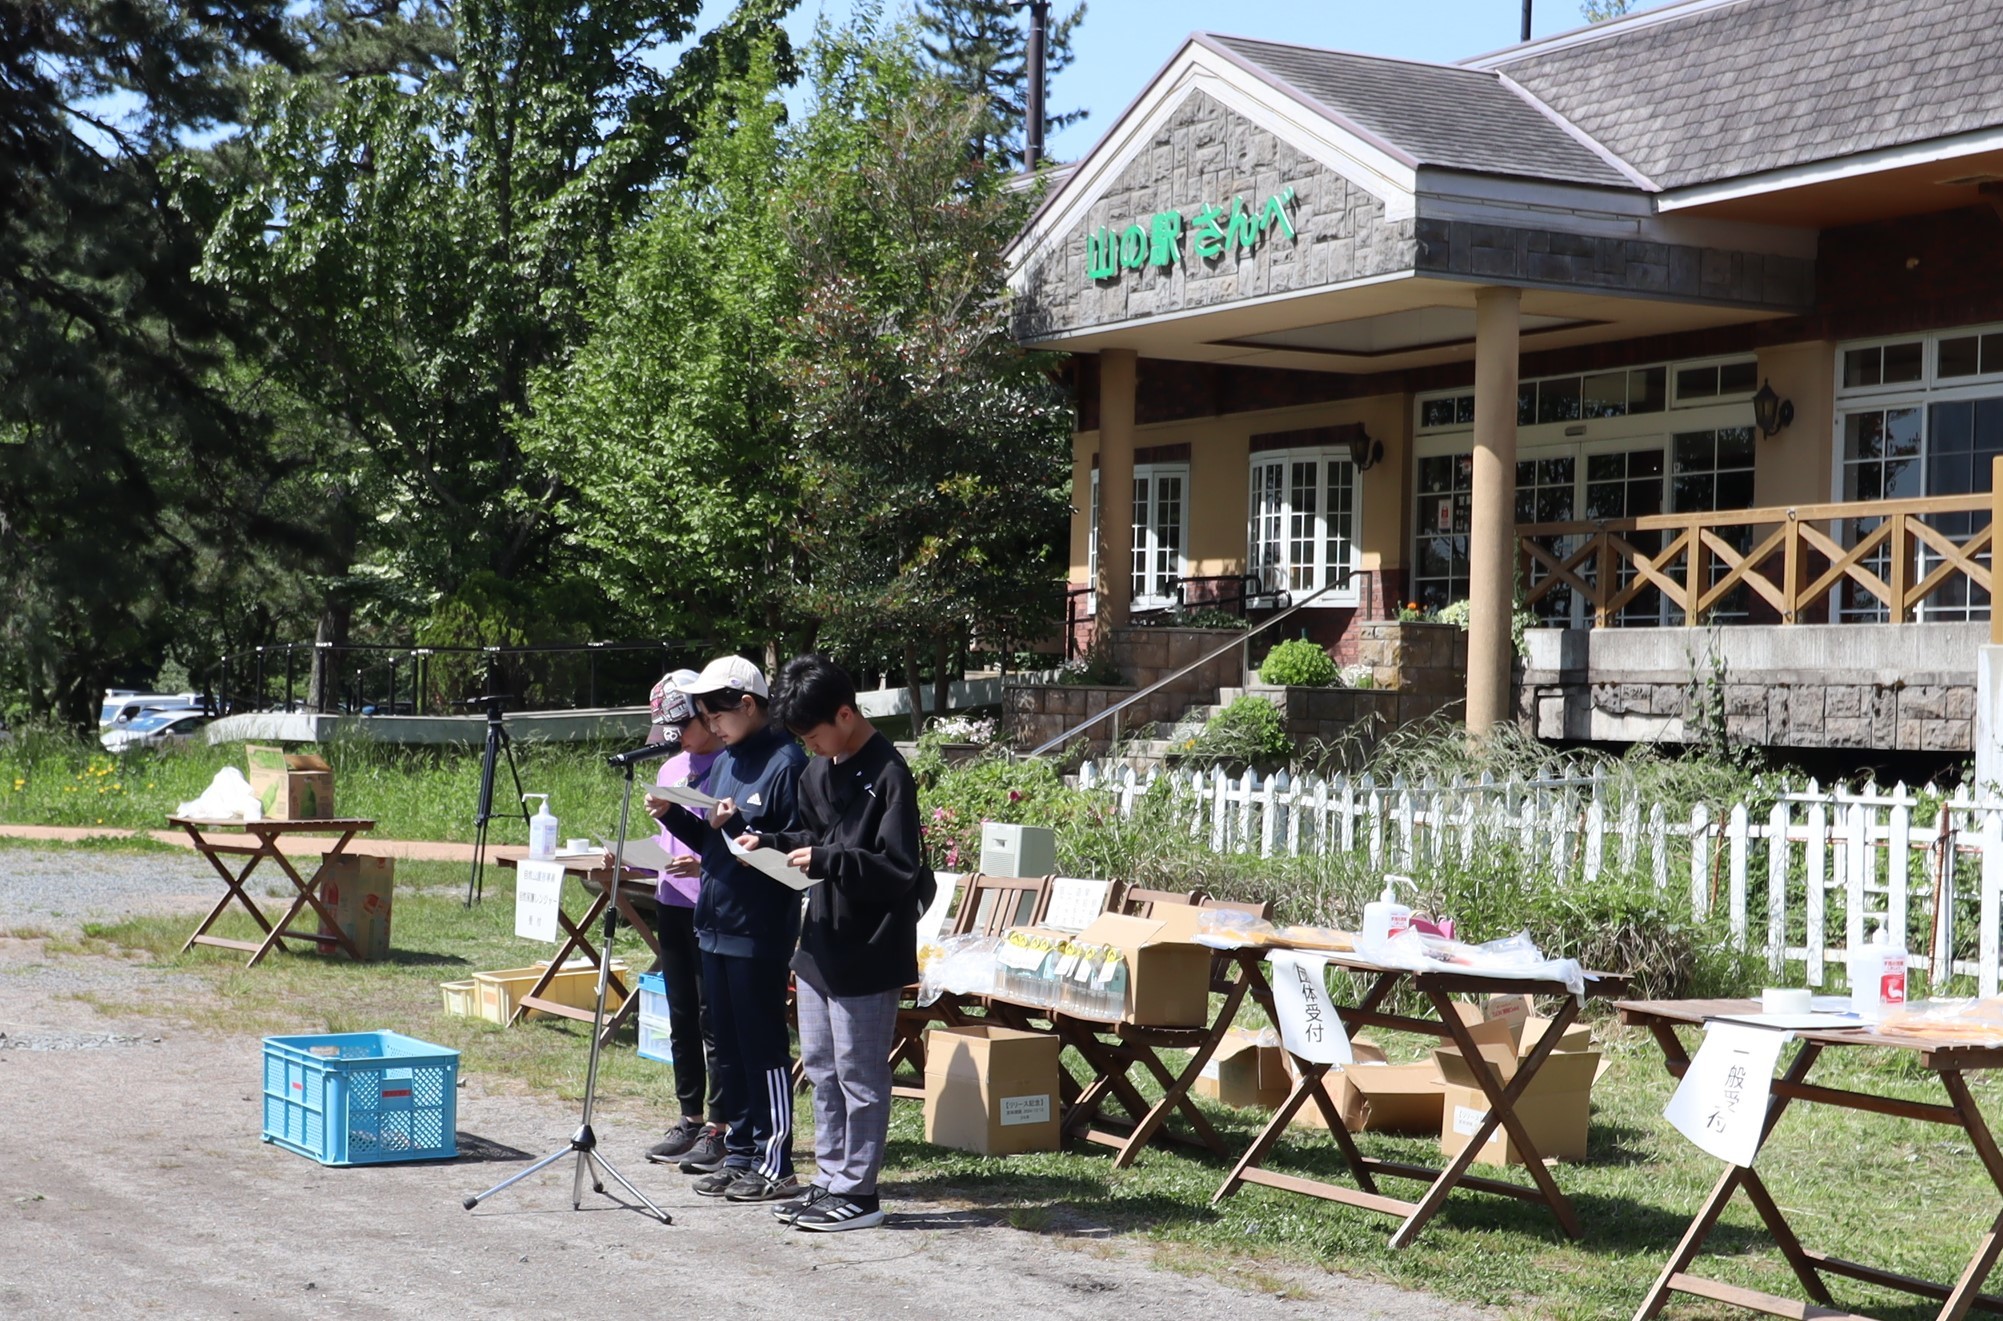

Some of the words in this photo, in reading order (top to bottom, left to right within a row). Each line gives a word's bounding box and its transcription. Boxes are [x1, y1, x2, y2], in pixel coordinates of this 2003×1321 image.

[1293, 962, 1324, 1043] 団体受付
[1706, 1049, 1750, 1134] 一般受付
